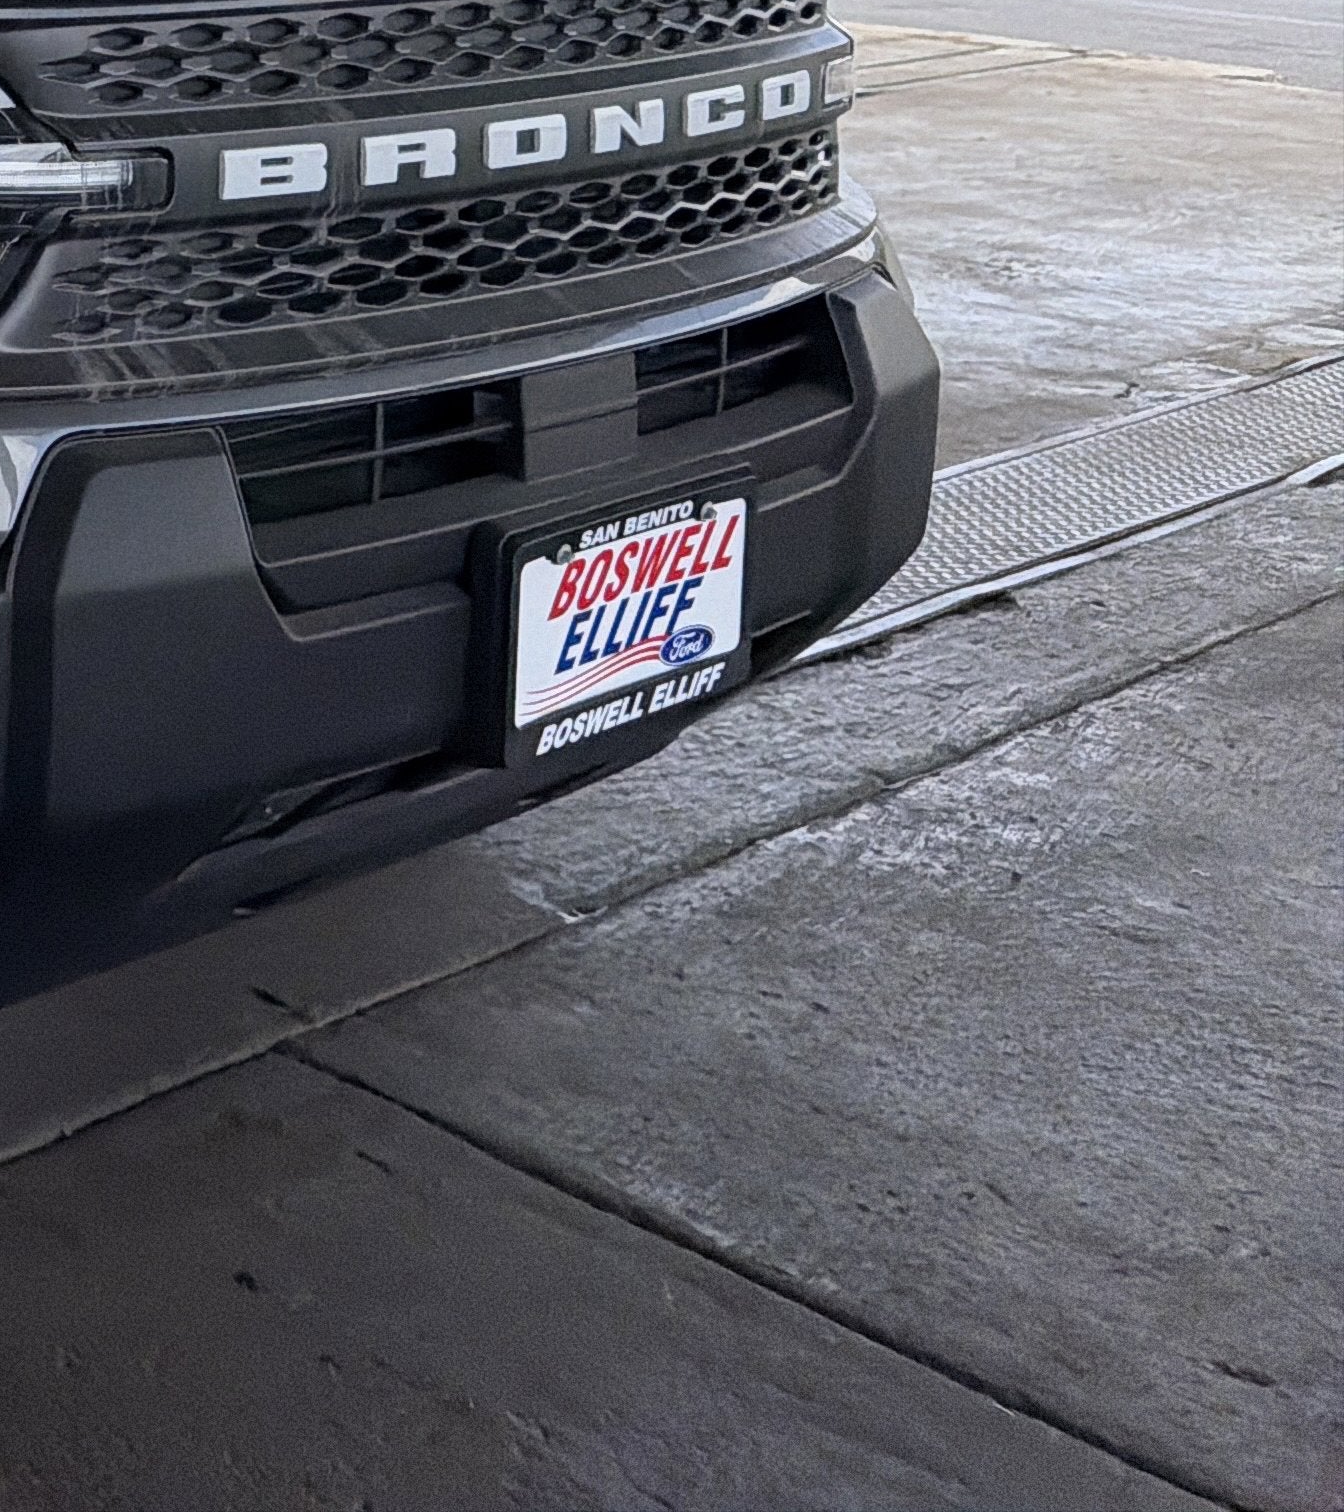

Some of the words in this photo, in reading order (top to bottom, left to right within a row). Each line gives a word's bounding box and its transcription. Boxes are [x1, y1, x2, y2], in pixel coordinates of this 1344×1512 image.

[222, 70, 810, 199] BRONCO
[547, 515, 740, 621] BOSWELL
[579, 520, 620, 549] SAN
[624, 500, 693, 535] BENITO
[554, 576, 705, 675] ELLIFF
[669, 633, 705, 661] Ford
[536, 691, 644, 756] BOSWELL
[648, 662, 726, 715] ELLIFF
